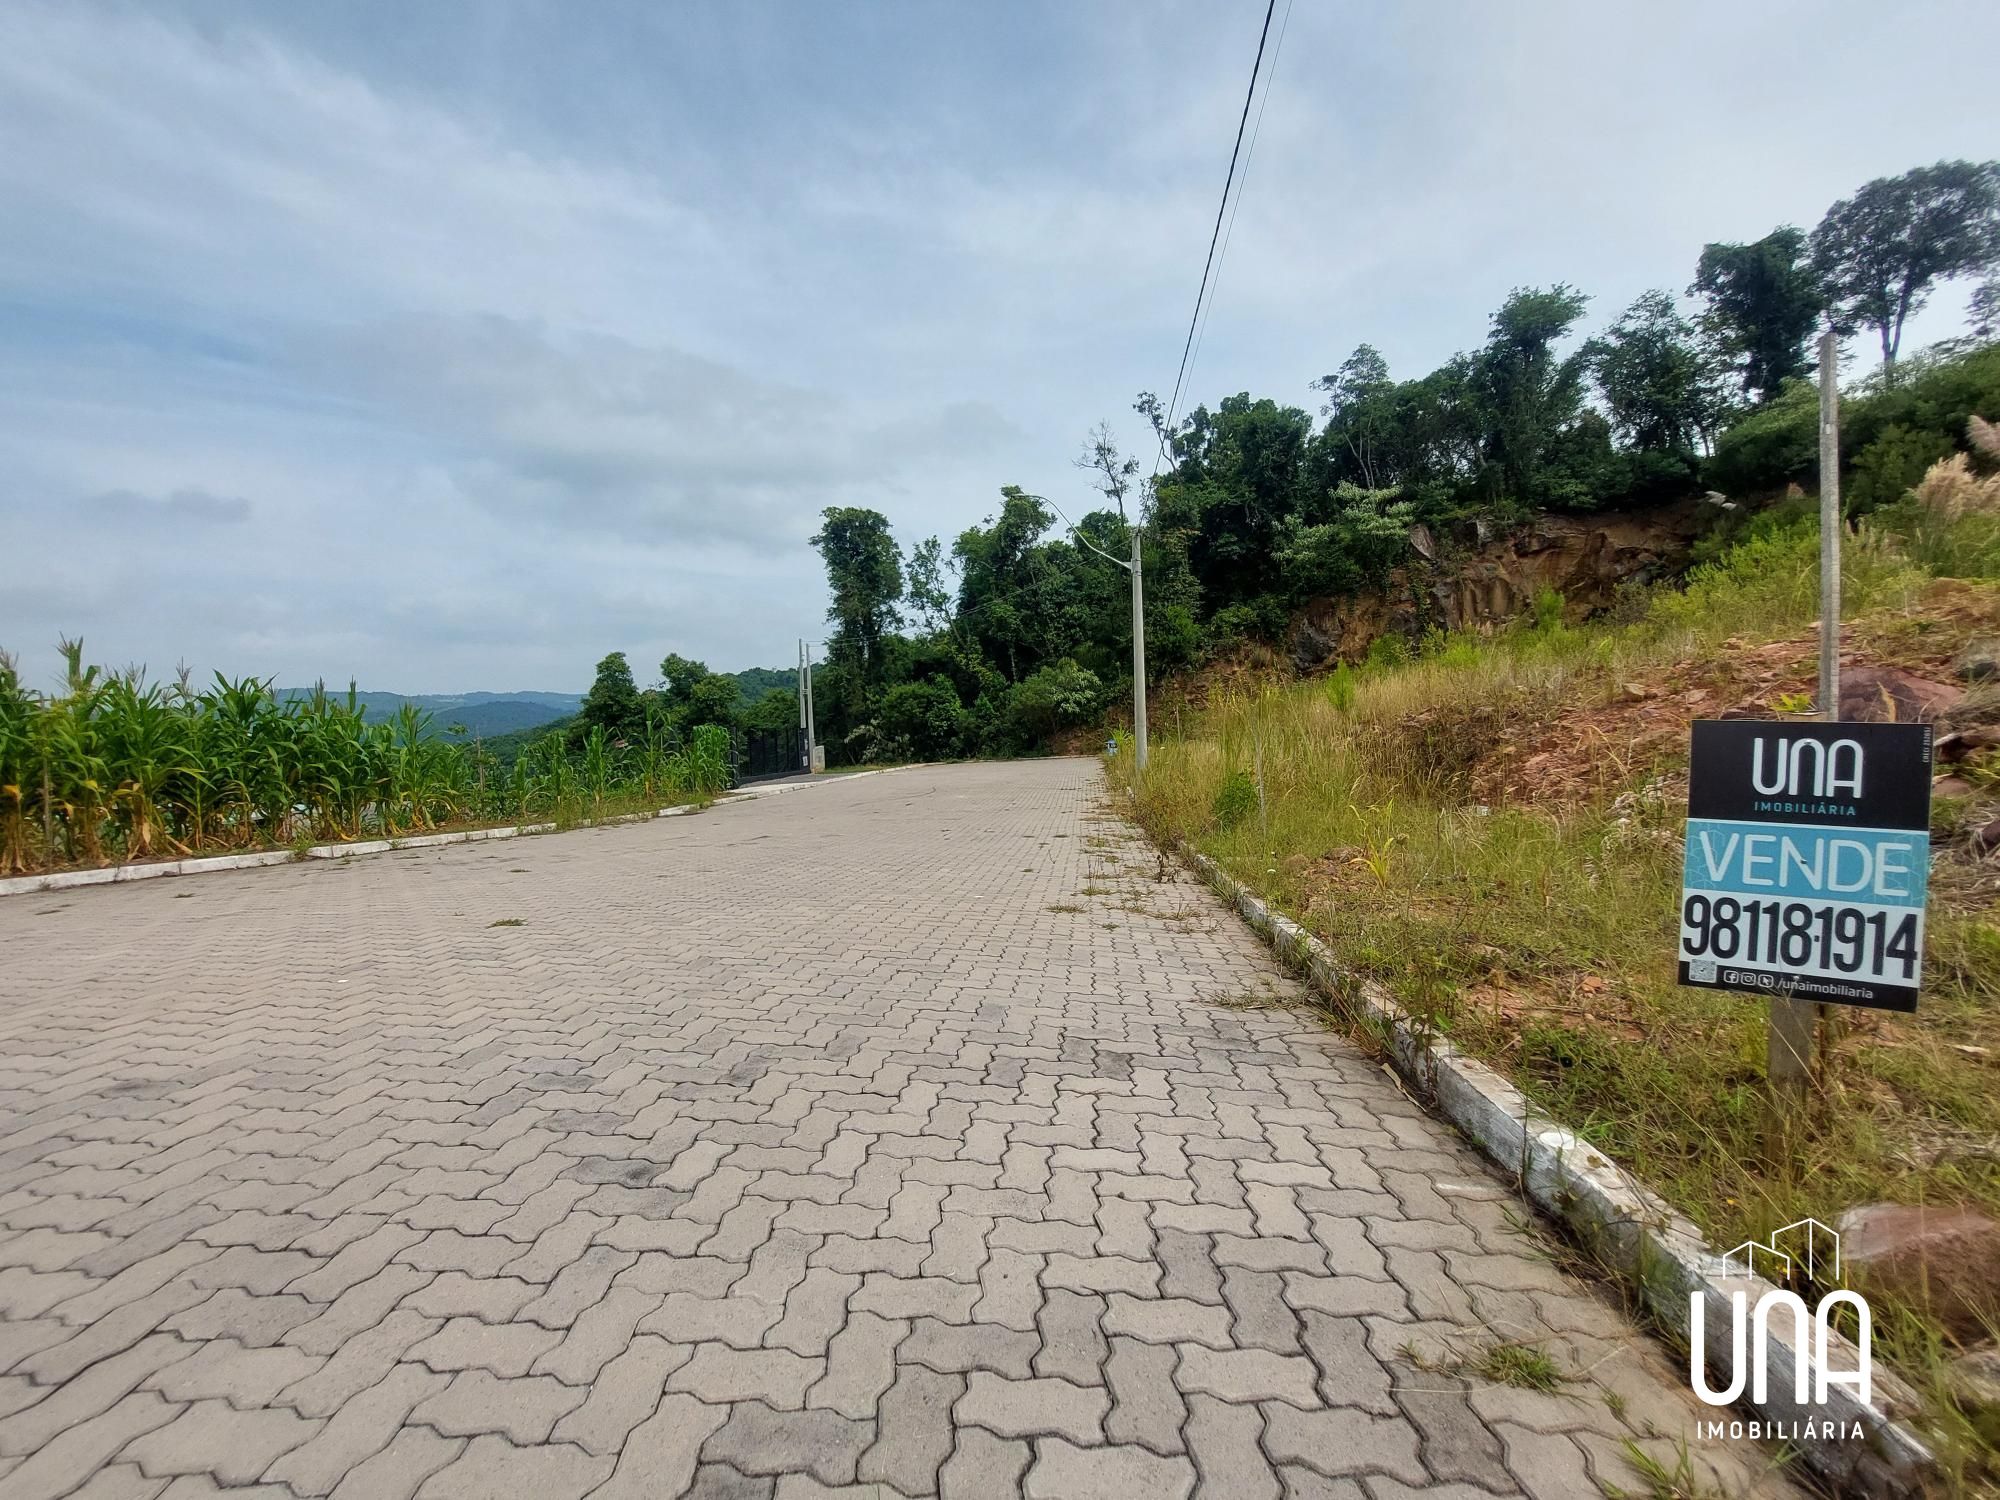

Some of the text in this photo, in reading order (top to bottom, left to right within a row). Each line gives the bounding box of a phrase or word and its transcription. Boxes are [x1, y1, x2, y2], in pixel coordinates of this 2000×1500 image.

[1752, 737, 1864, 798] UNA
[1754, 801, 1857, 816] IMOBILIÁRIA
[1700, 830, 1912, 897] VENDE
[1777, 977, 1874, 999] /unaimobiliaria
